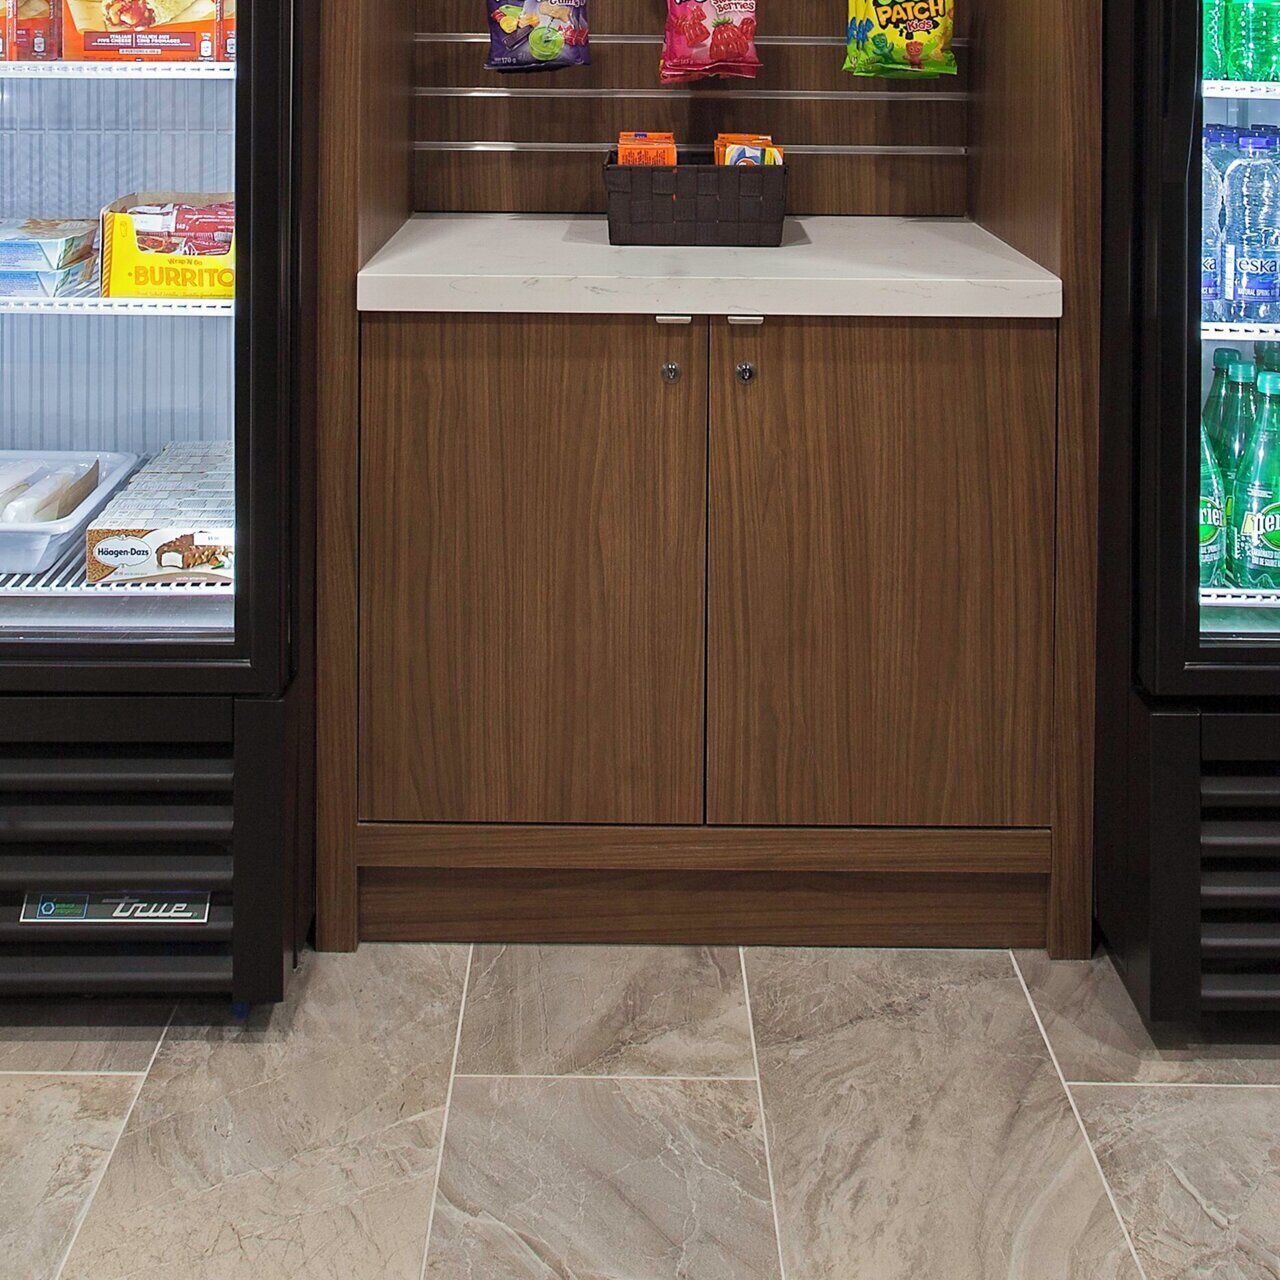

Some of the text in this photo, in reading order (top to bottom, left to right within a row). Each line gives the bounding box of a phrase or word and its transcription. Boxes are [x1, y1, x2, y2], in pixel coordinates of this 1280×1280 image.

[716, 1, 755, 14] Berries
[906, 19, 934, 33] Kids
[1237, 258, 1278, 273] eska
[134, 266, 234, 288] BURRITO
[97, 546, 149, 559] Häagen-Dazs
